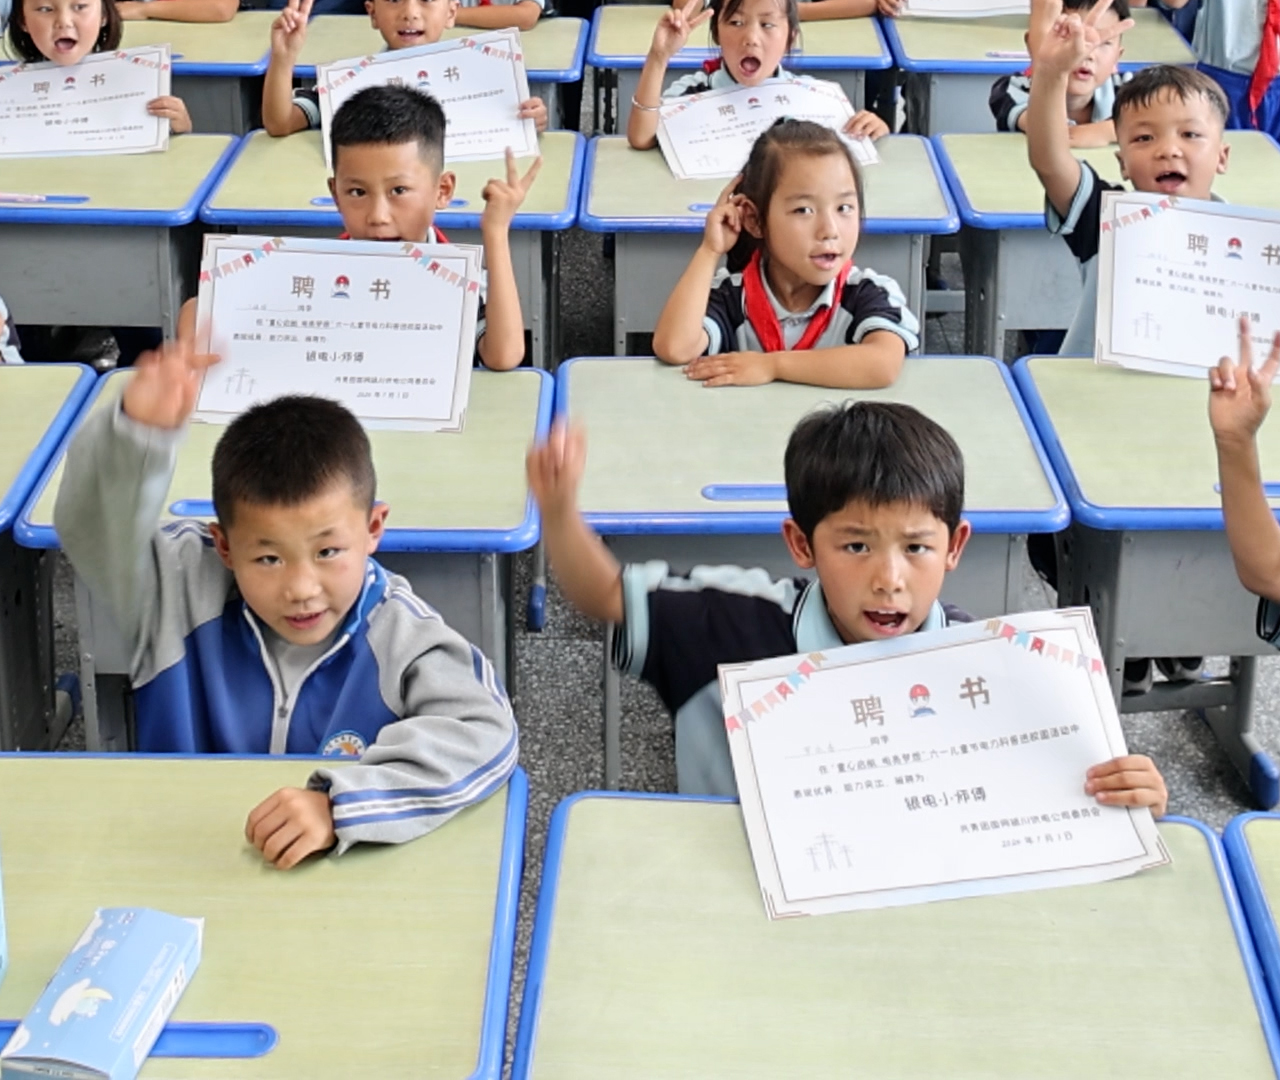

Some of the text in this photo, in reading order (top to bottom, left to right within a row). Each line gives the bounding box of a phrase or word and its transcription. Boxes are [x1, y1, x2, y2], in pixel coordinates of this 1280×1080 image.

[443, 66, 462, 83] 书
[1187, 233, 1209, 256] 聘
[291, 275, 391, 301] 聘 书
[850, 676, 991, 727] 聘 书
